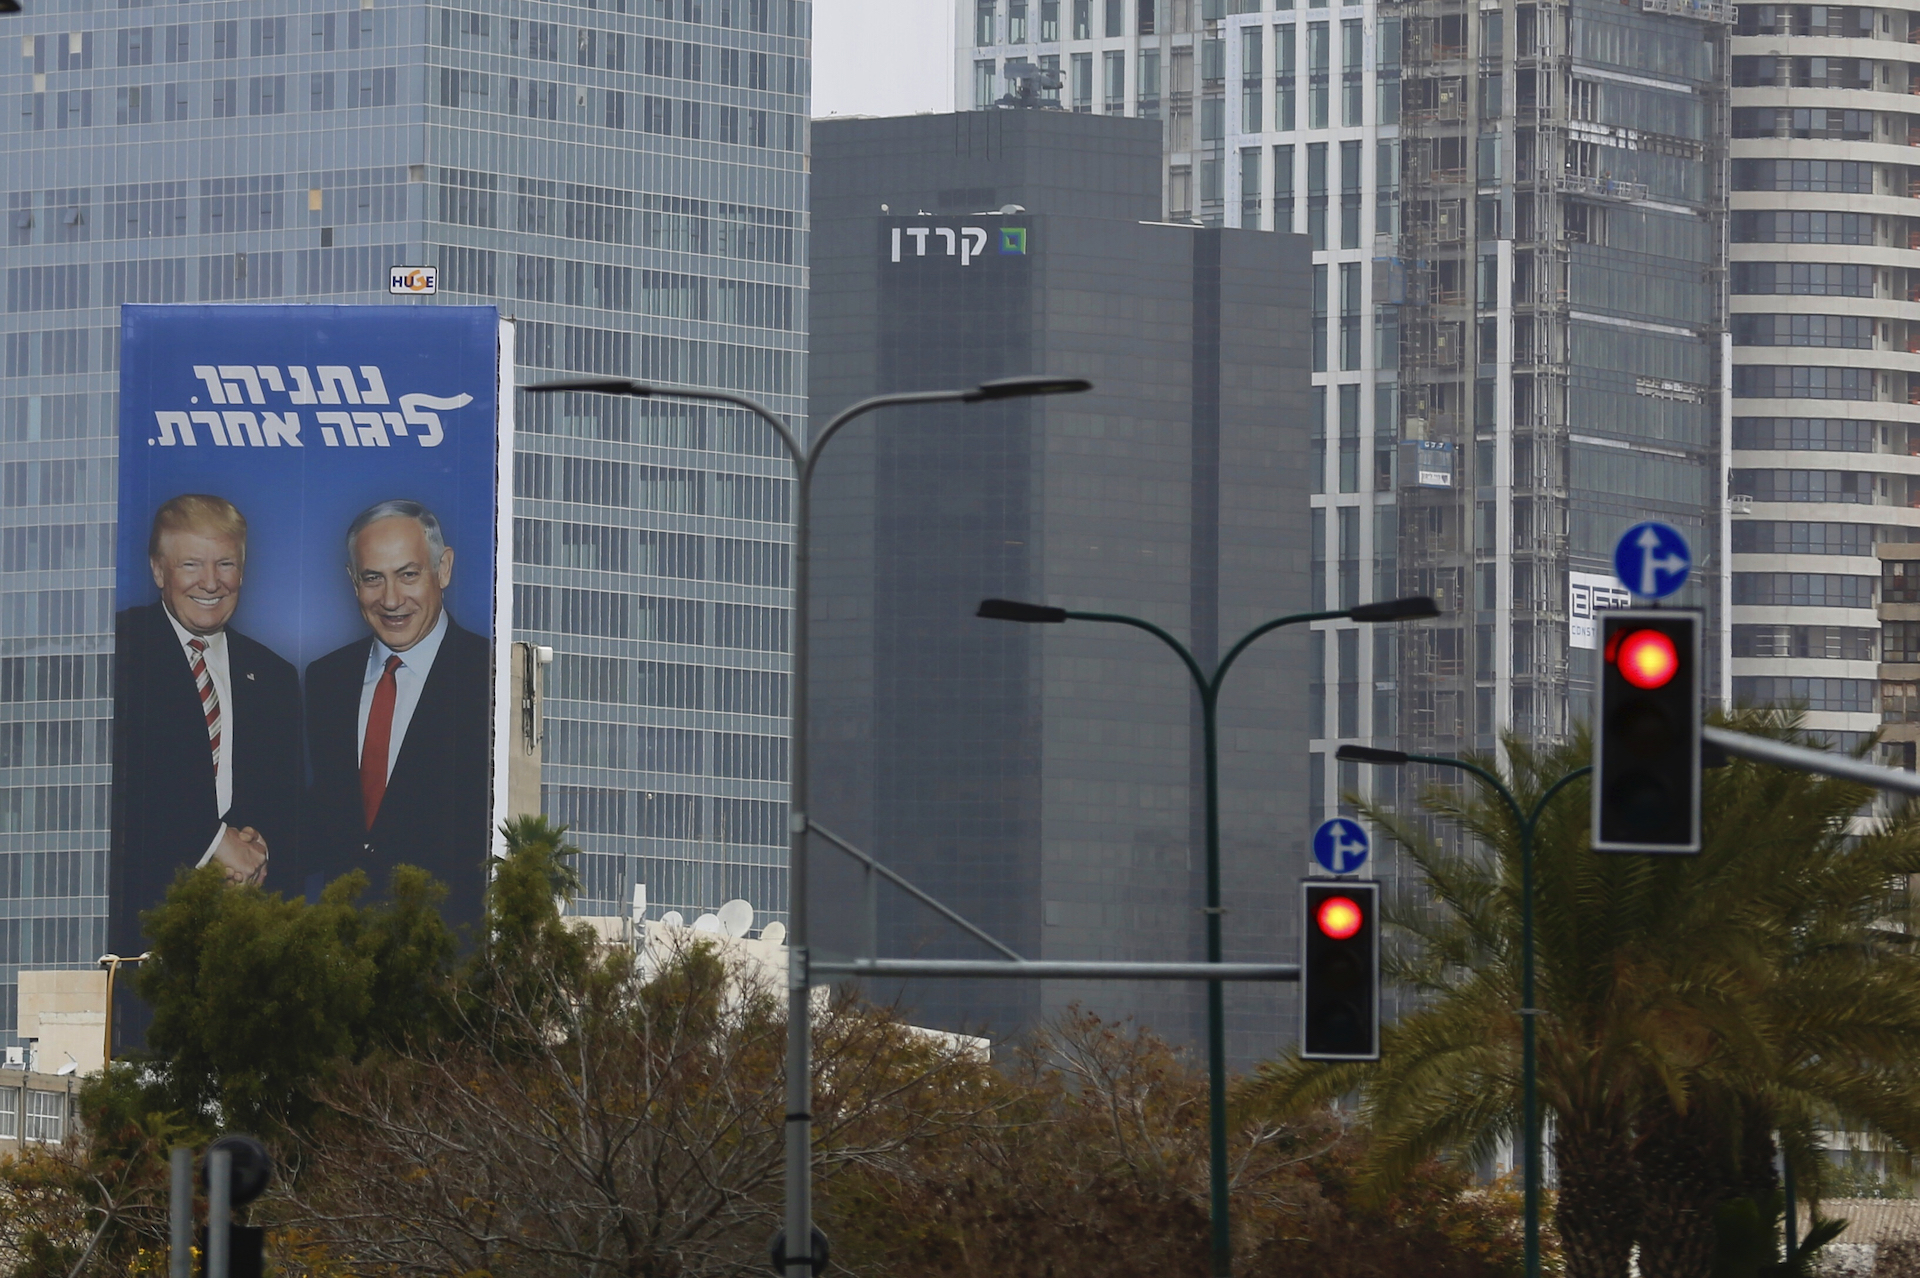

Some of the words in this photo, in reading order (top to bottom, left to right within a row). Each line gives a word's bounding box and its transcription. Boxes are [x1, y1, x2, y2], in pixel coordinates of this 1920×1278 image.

[891, 226, 988, 266] קרדן
[392, 269, 434, 291] HUGE
[190, 365, 391, 405] נתניהו.
[147, 410, 304, 447] אחרת.
[315, 392, 474, 448] ליגה
